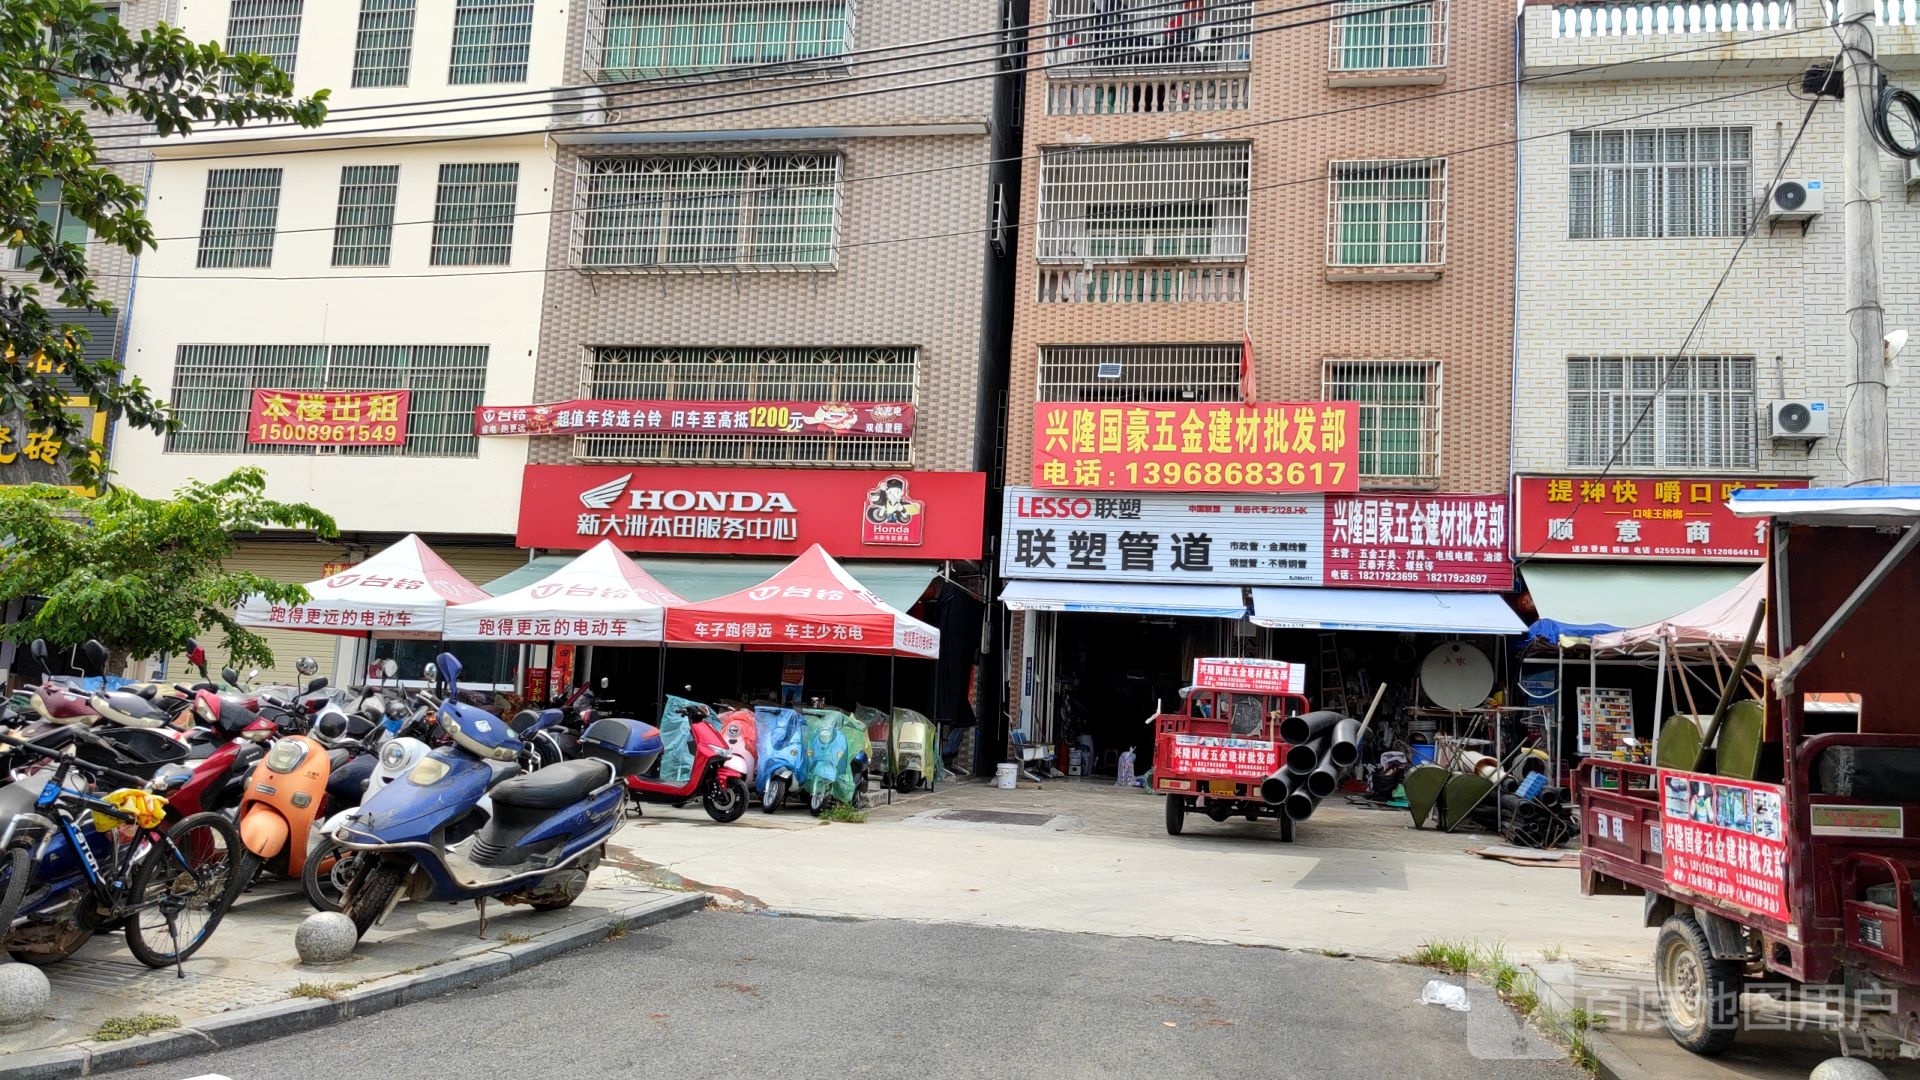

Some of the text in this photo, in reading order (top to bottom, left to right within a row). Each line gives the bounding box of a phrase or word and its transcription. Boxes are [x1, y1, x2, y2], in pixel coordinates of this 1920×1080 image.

[262, 394, 399, 423] 本楼出租
[498, 409, 526, 422] 台铃
[557, 407, 804, 430] 超值年货选台铃 旧车至高抵1200元
[865, 406, 902, 416] 一次充电
[259, 423, 397, 442] 15008961549
[865, 423, 903, 434] 双倍里程
[1045, 407, 1346, 454] 兴隆国豪五金建材批发部
[628, 490, 798, 513] HONDA
[1548, 479, 1638, 504] 提神快
[1017, 496, 1141, 520] LESSO 联塑
[1632, 508, 1683, 520] 口味王槟榔
[576, 513, 798, 541] 新大洲本田服务中心
[873, 525, 909, 534] Honda
[1332, 499, 1505, 548] 兴隆国豪五金建材批发部
[1014, 527, 1214, 572] 联塑管道
[1426, 572, 1488, 583] 18217923697
[782, 586, 844, 601] 台铃
[269, 606, 412, 627] 跑得更远的电动车
[478, 618, 627, 637] 跑得更远的电动车
[694, 622, 863, 641] 车子跑得远 车主少充电
